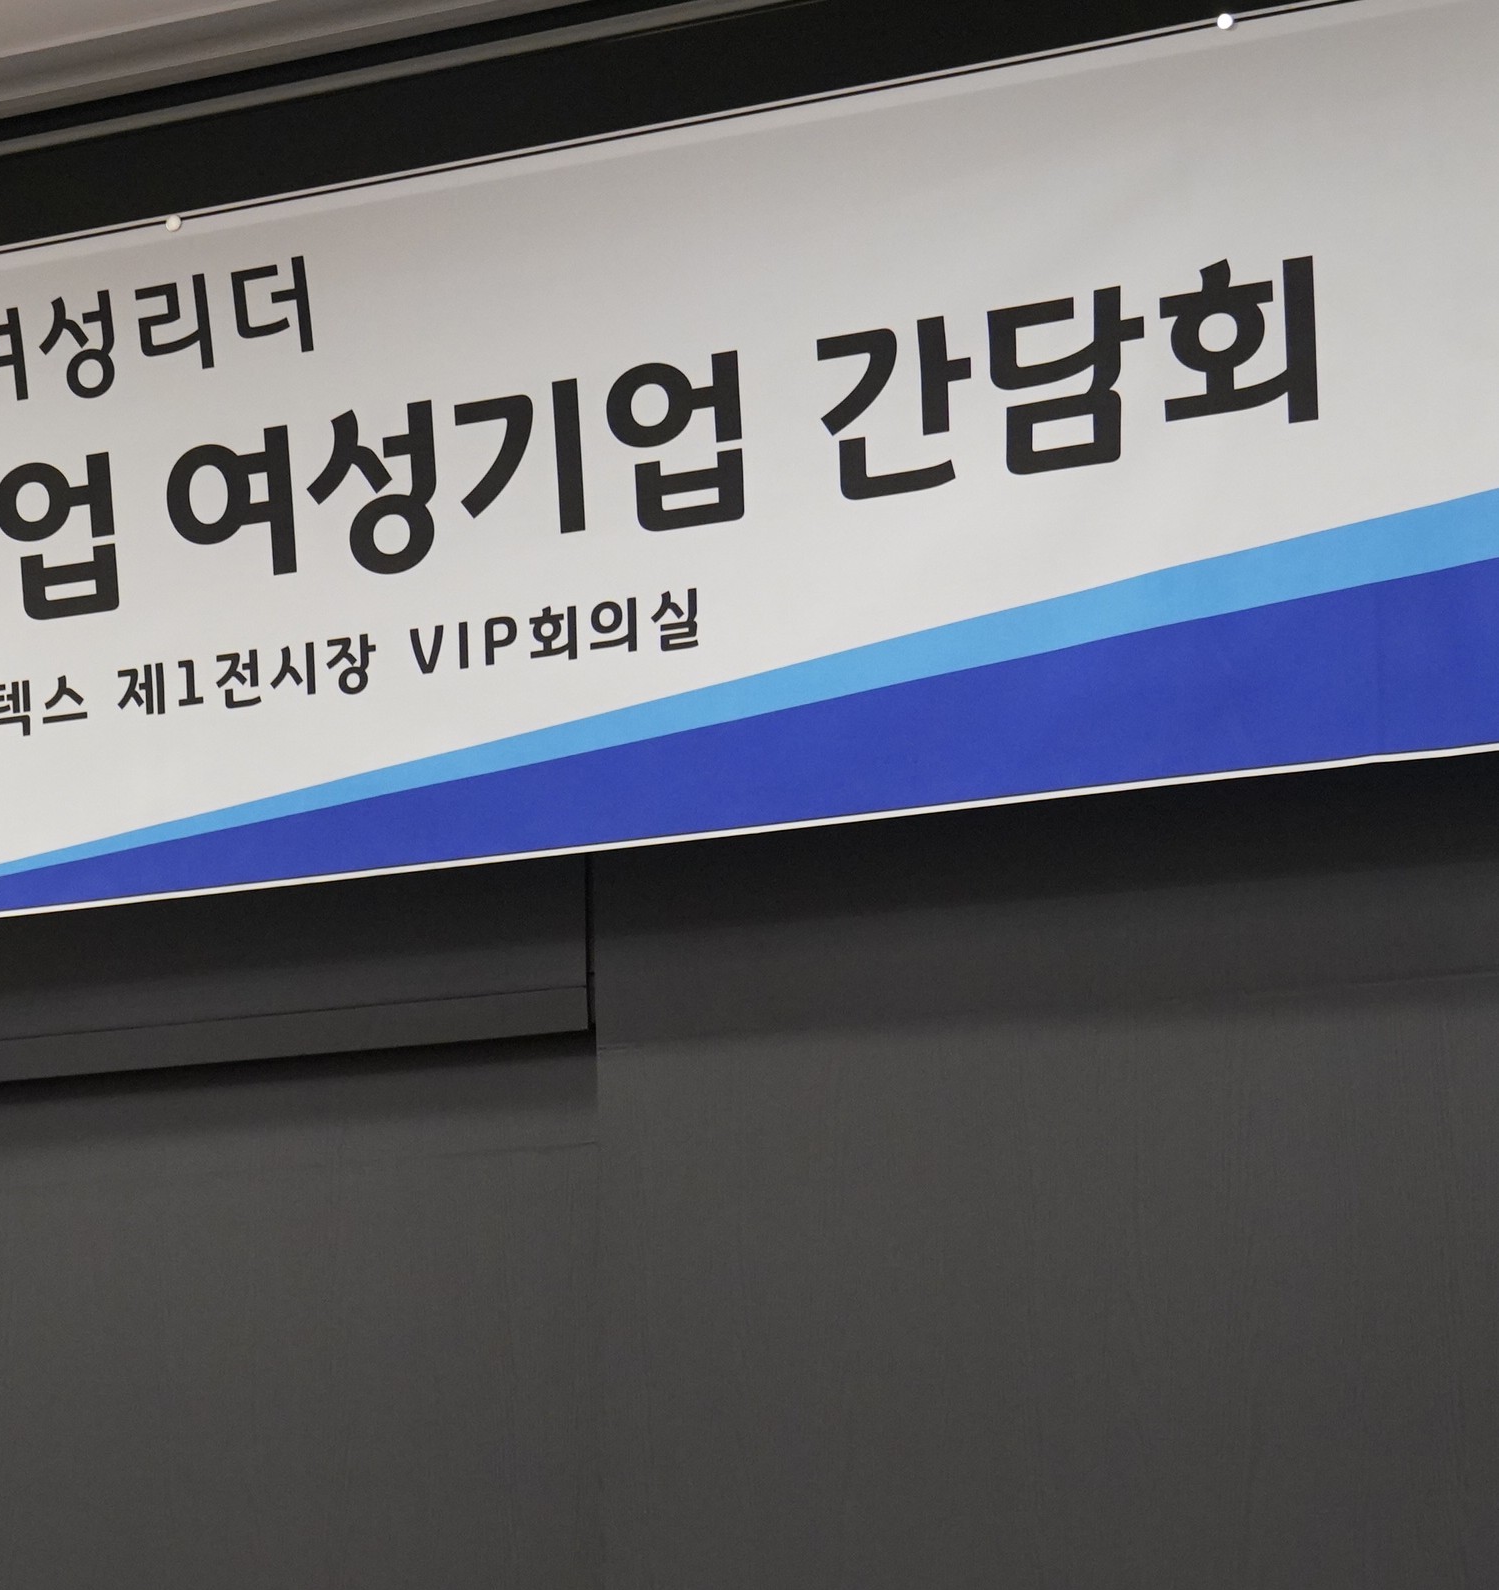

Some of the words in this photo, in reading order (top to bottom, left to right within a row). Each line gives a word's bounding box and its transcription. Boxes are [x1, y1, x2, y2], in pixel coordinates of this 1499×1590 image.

[166, 349, 746, 576] 여성기업
[816, 255, 1320, 501] 간담회
[117, 633, 378, 715] 제1전시장
[409, 586, 701, 676] VIP회의실
